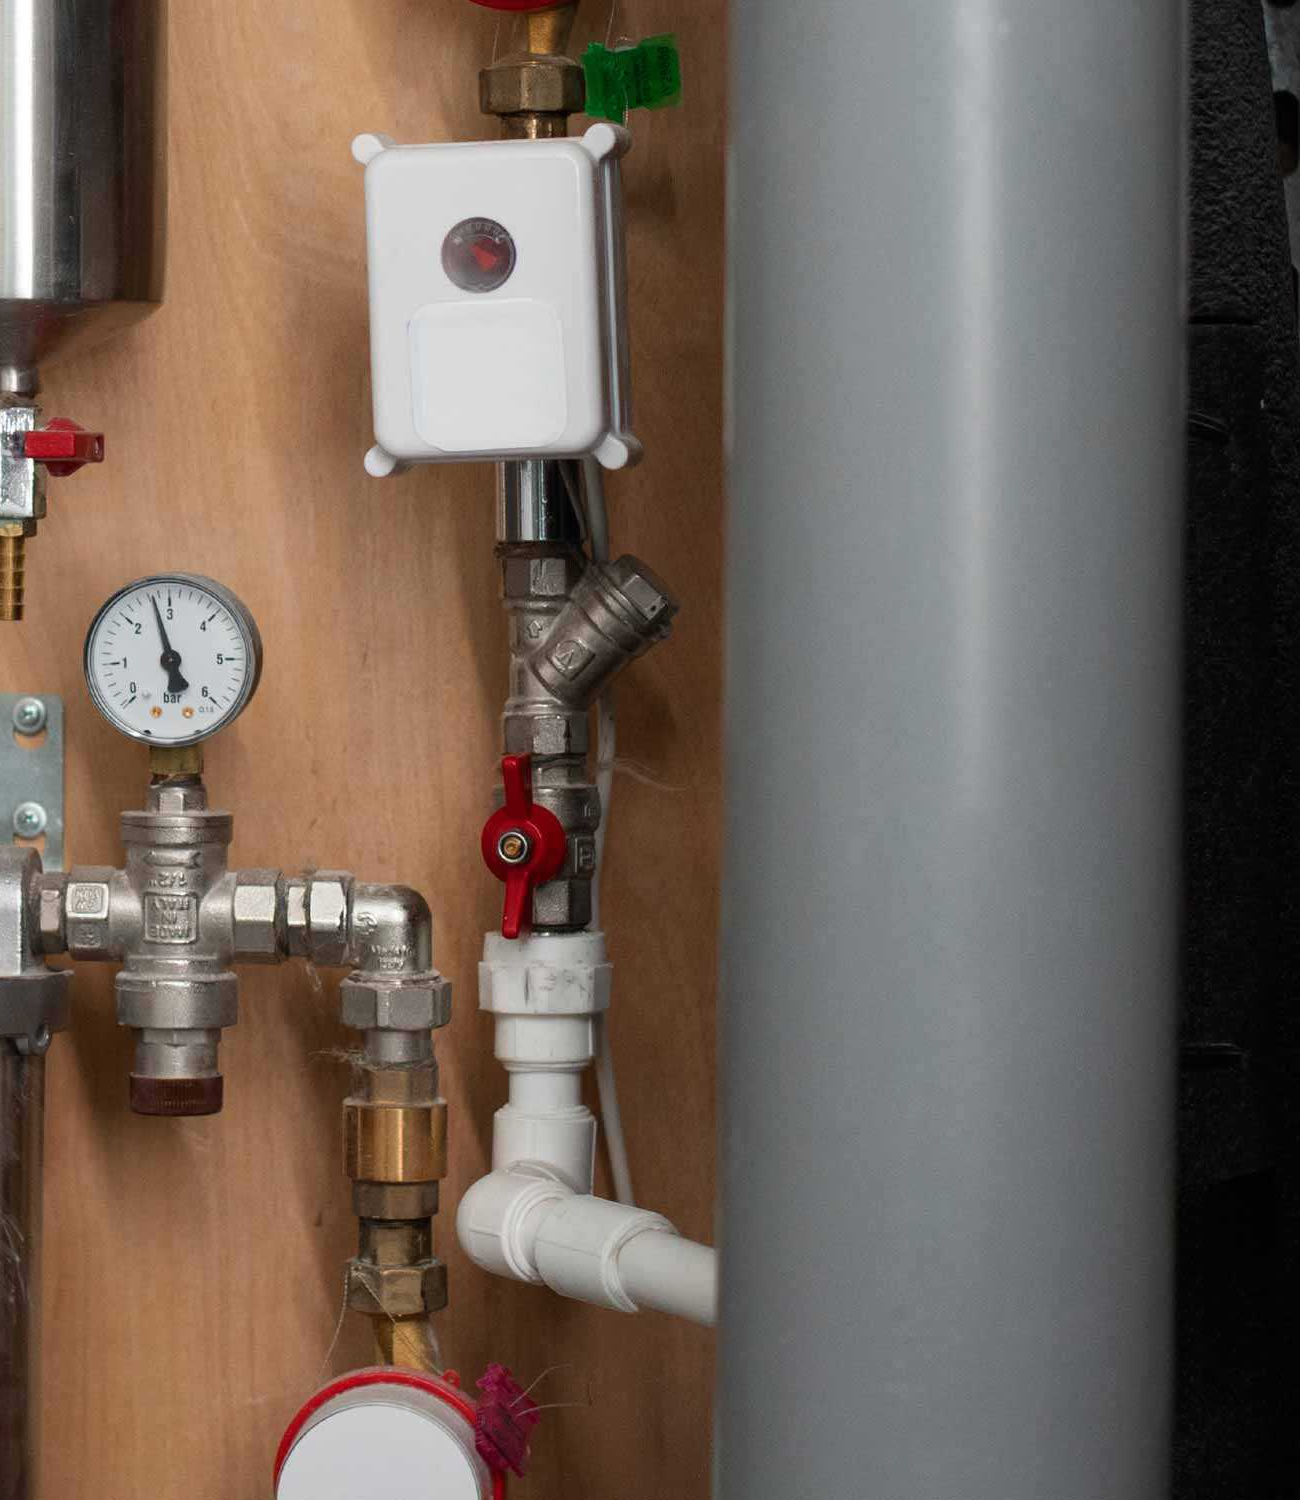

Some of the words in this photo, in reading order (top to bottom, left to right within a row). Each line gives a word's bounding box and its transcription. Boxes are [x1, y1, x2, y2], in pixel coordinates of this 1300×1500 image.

[166, 608, 173, 620] 3
[134, 622, 142, 635] 2
[199, 620, 207, 632] 4
[122, 656, 128, 669] 1
[216, 653, 223, 665] 5
[129, 681, 137, 694] 0
[201, 686, 209, 698] 6
[163, 692, 182, 704] bar
